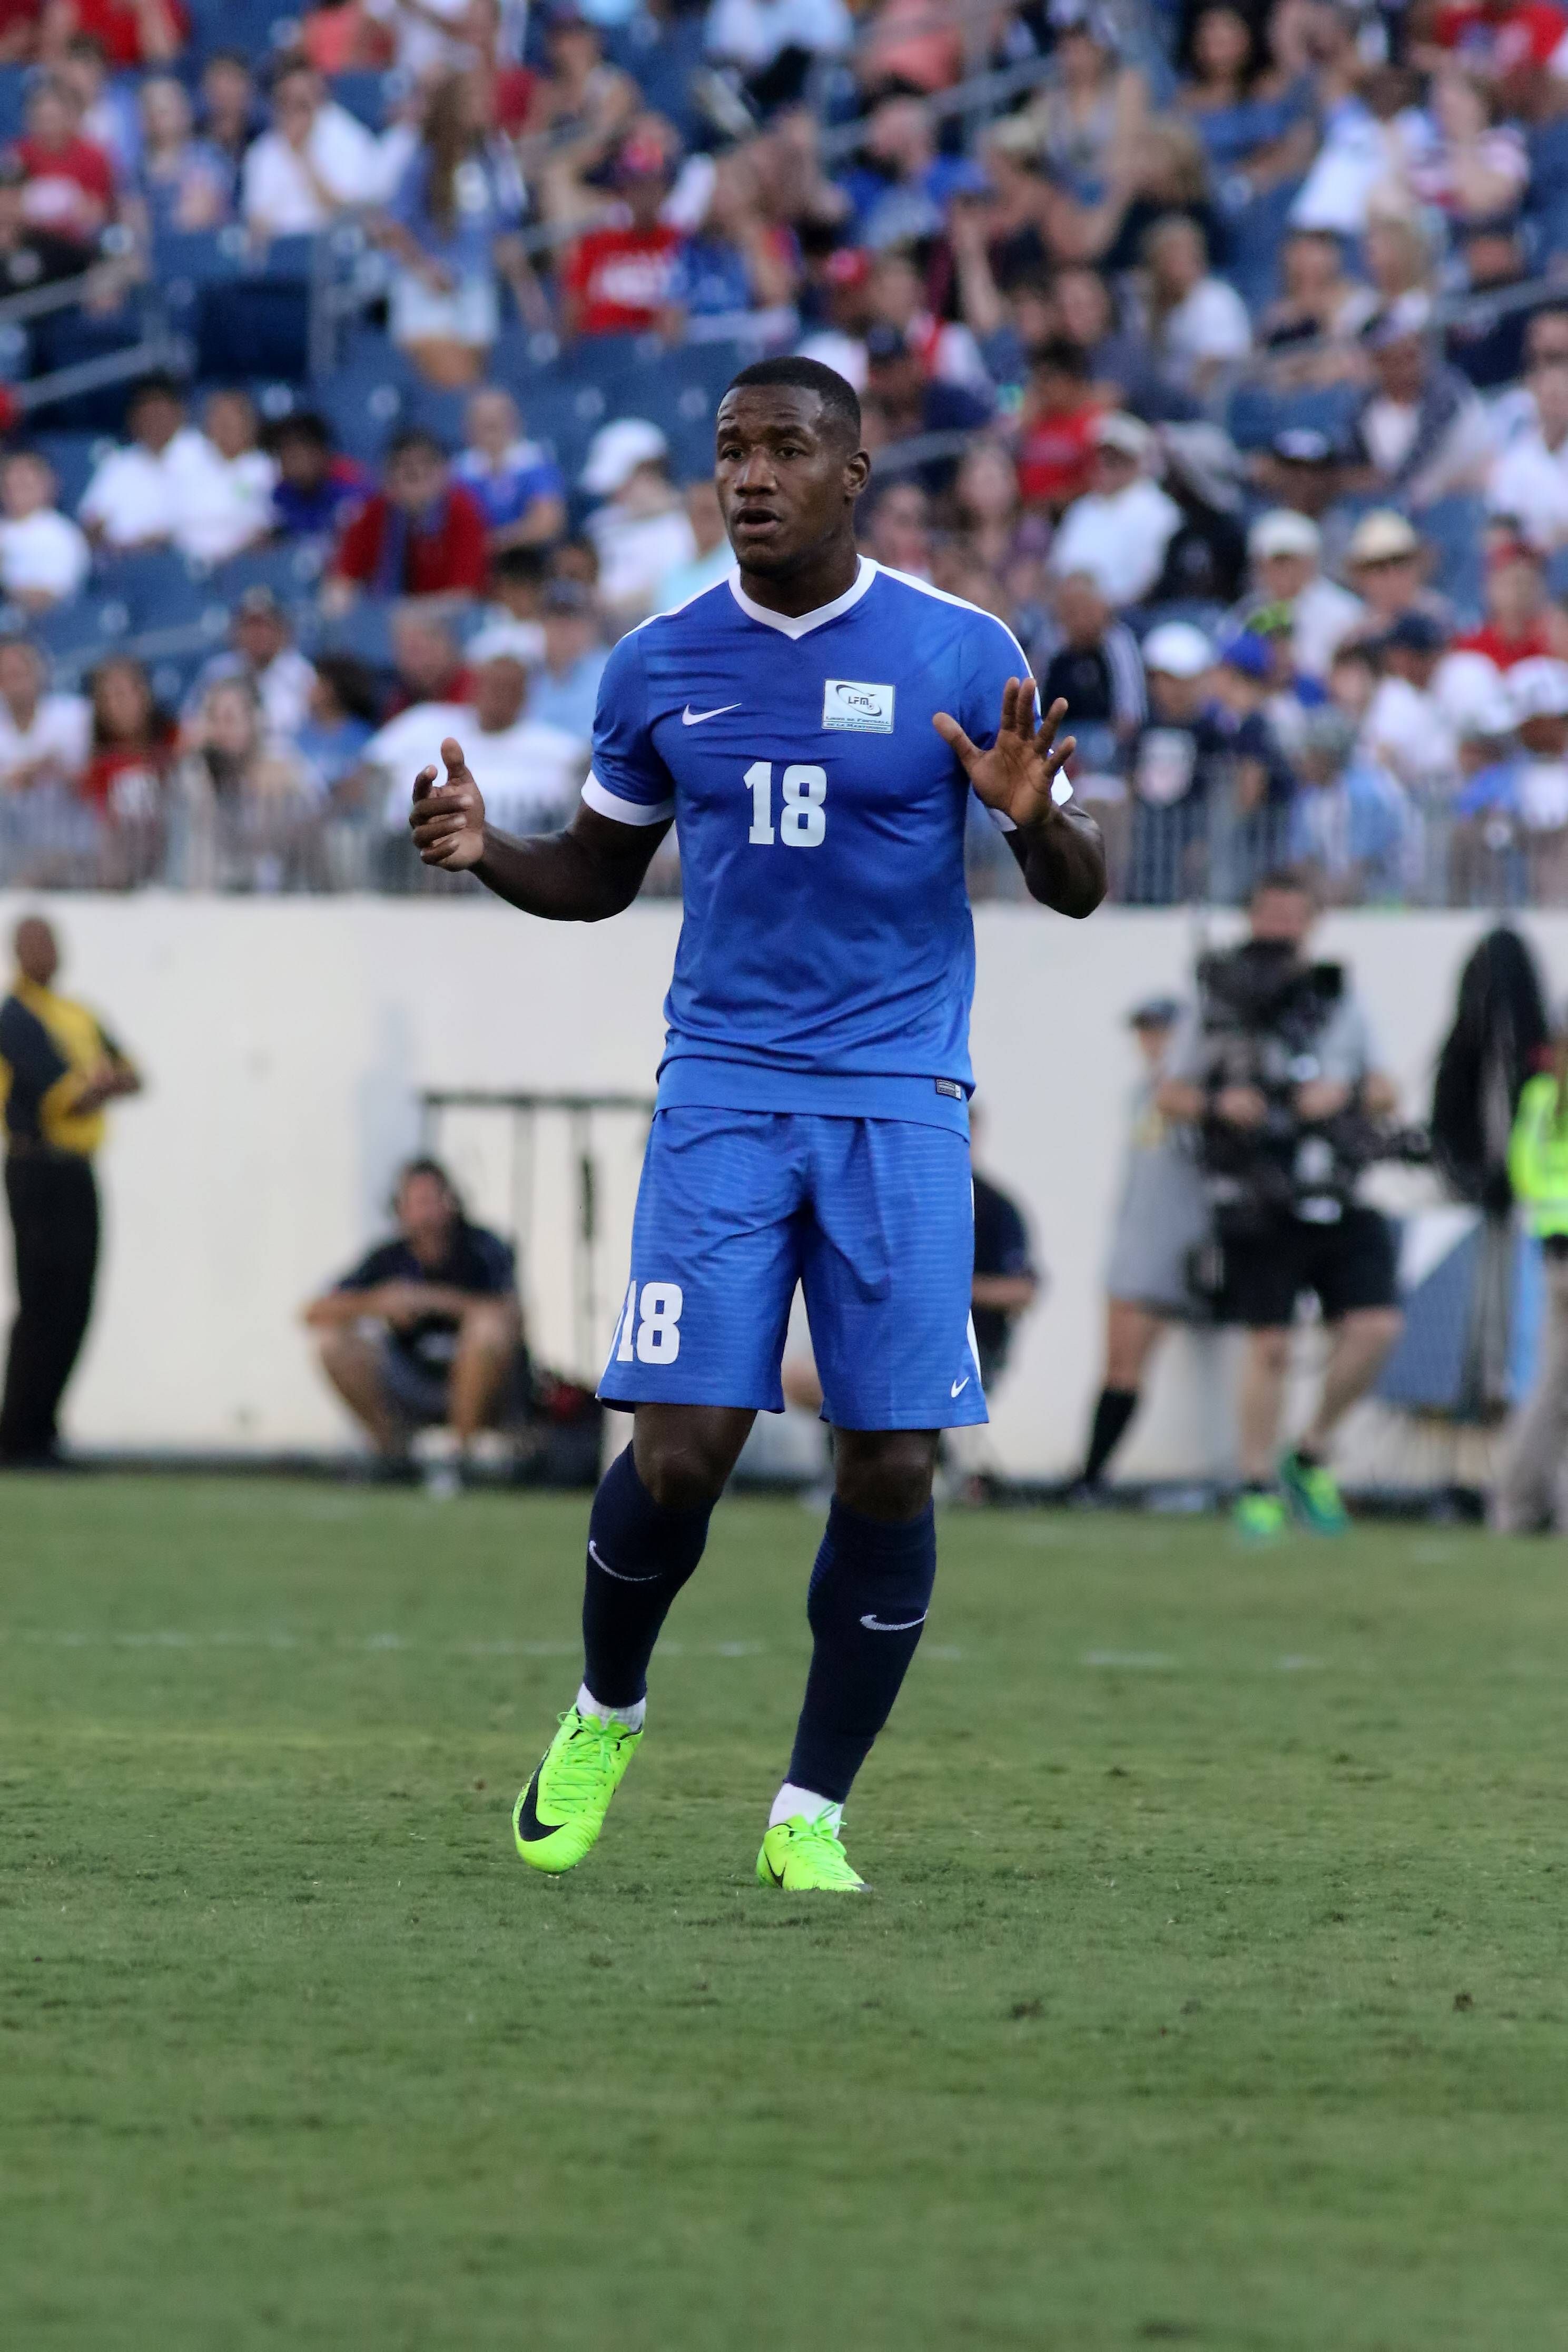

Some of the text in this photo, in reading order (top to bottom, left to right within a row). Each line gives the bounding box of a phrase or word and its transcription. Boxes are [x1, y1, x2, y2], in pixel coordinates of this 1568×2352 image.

[848, 696, 869, 705] LFM
[743, 761, 827, 847] 18
[616, 1280, 684, 1365] 18
